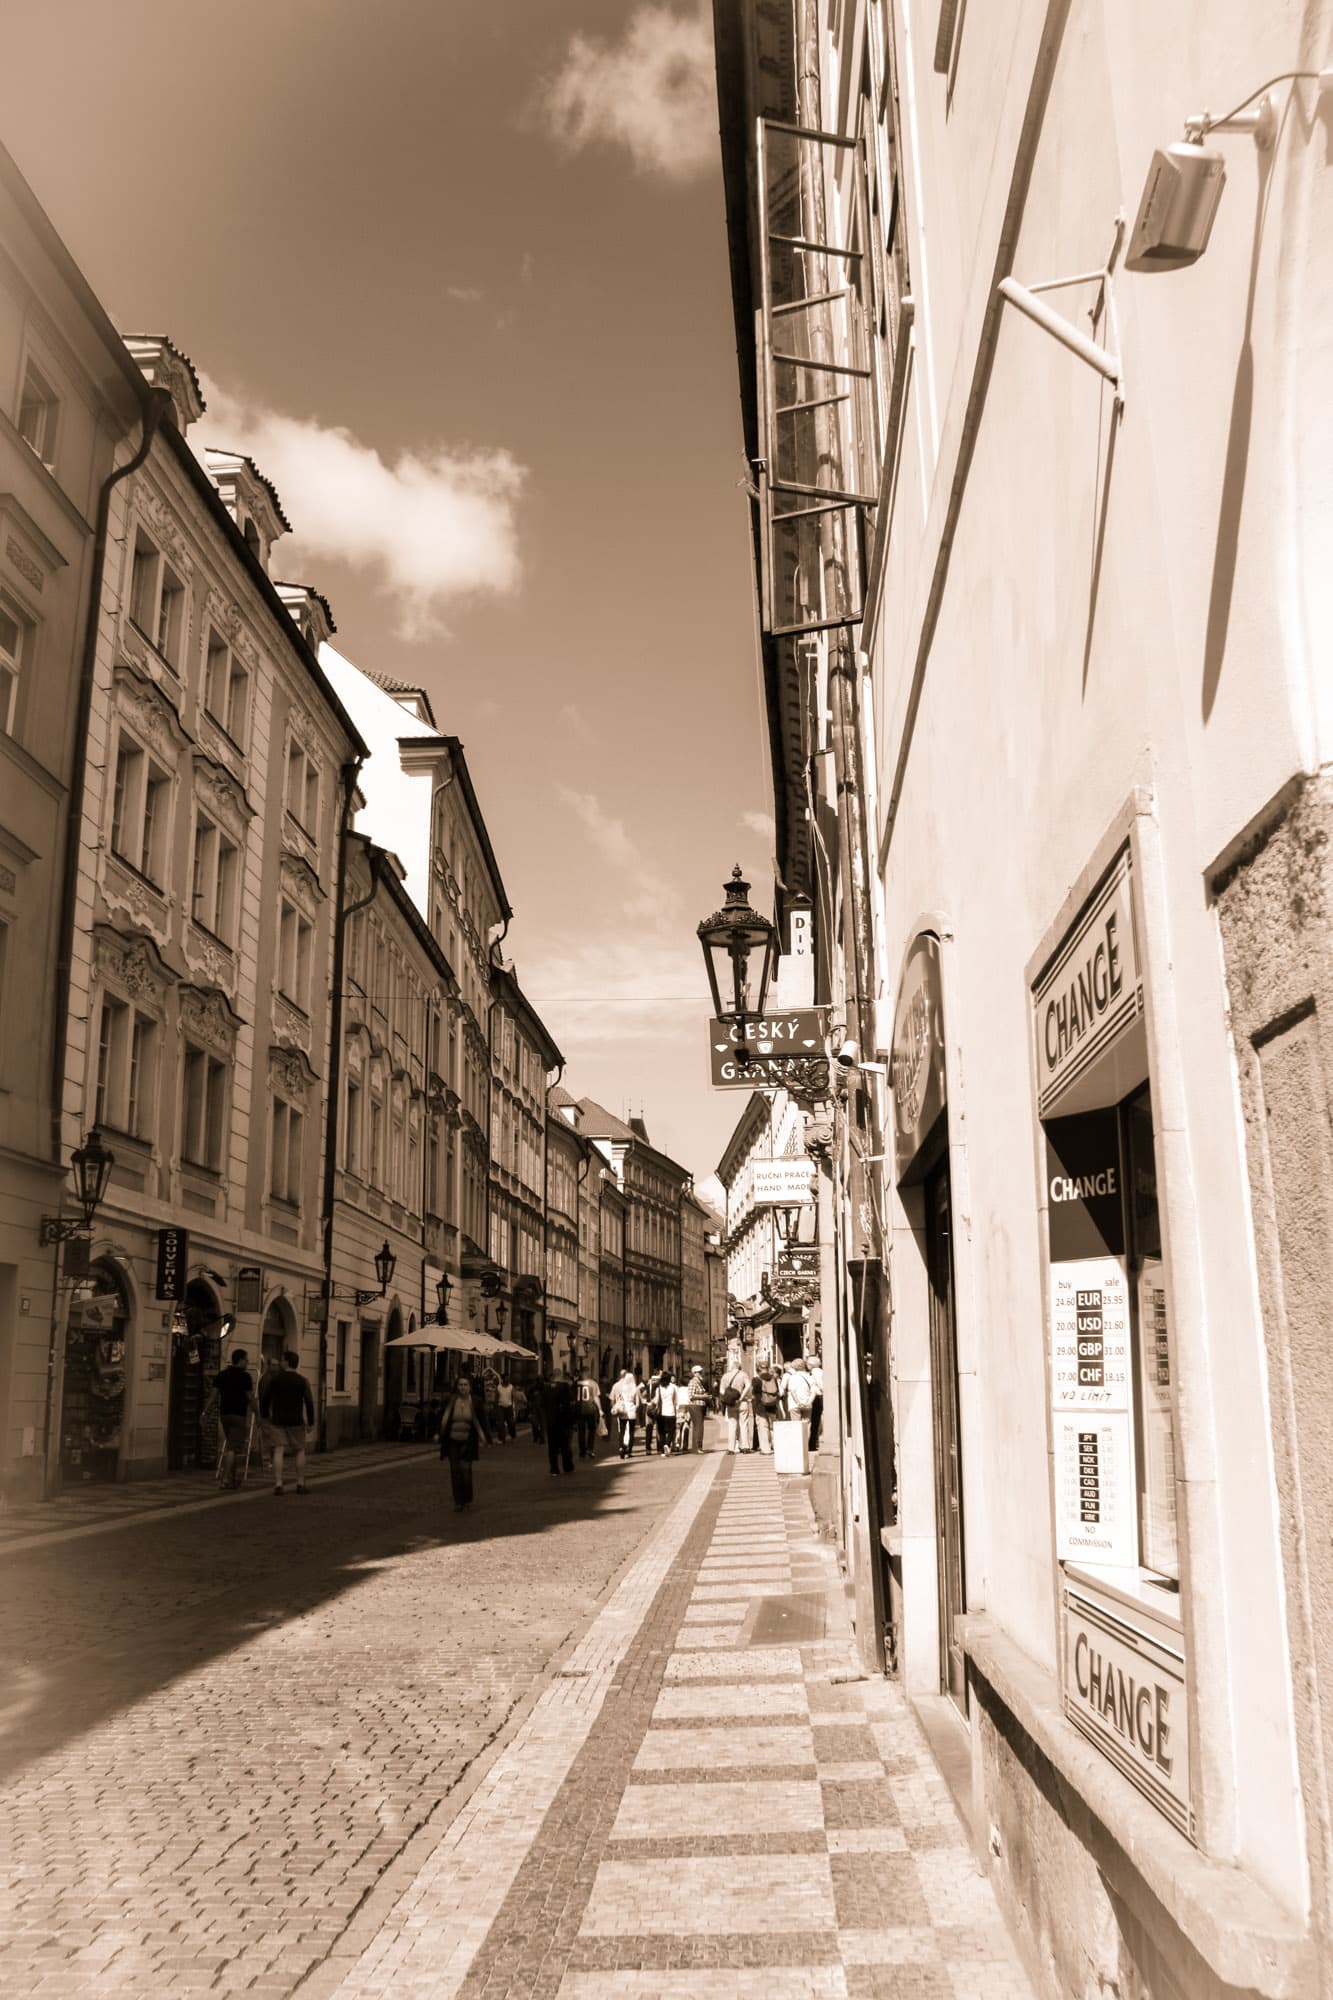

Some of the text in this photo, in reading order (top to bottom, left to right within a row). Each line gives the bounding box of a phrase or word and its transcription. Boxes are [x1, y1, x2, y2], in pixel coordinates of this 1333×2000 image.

[1045, 909, 1123, 1072] CHANGE
[757, 1184, 782, 1192] HAND
[1050, 1168, 1117, 1202] CHANGE
[164, 1231, 177, 1298] SOUVENIRS
[1058, 1278, 1119, 1289] buy sale
[1077, 1292, 1101, 1307] EUR
[1078, 1317, 1101, 1331] USD
[1078, 1343, 1102, 1356] GBP
[1080, 1368, 1102, 1382] CHF
[577, 1386, 589, 1400] 10
[1060, 1391, 1075, 1400] NO
[1085, 1526, 1096, 1534] NO
[1069, 1537, 1113, 1549] COMMISSION
[1075, 1632, 1173, 1778] CHANGE
